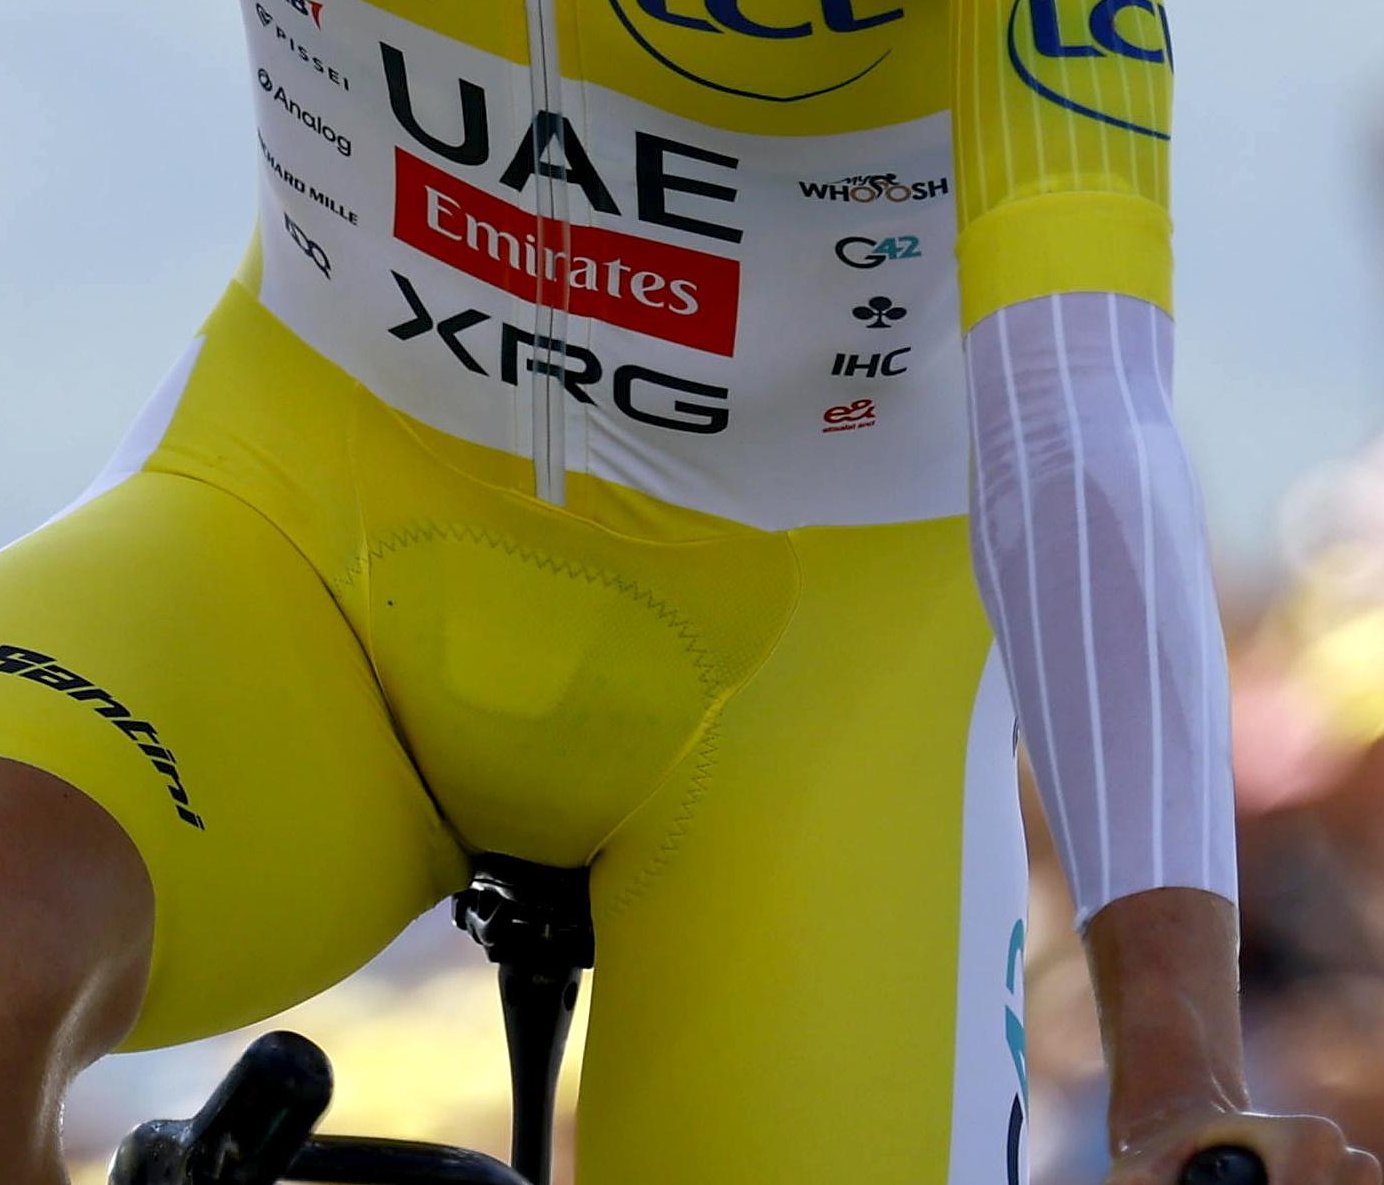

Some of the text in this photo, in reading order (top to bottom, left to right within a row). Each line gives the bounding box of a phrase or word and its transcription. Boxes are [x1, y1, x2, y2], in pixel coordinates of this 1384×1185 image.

[276, 26, 350, 91] PISSEI
[273, 86, 352, 157] Analog
[379, 41, 744, 244] UAE
[309, 186, 358, 226] MILLE
[424, 184, 700, 316] Emirates
[834, 235, 922, 269] G42
[388, 269, 730, 435] XRG
[831, 347, 912, 378] IHC
